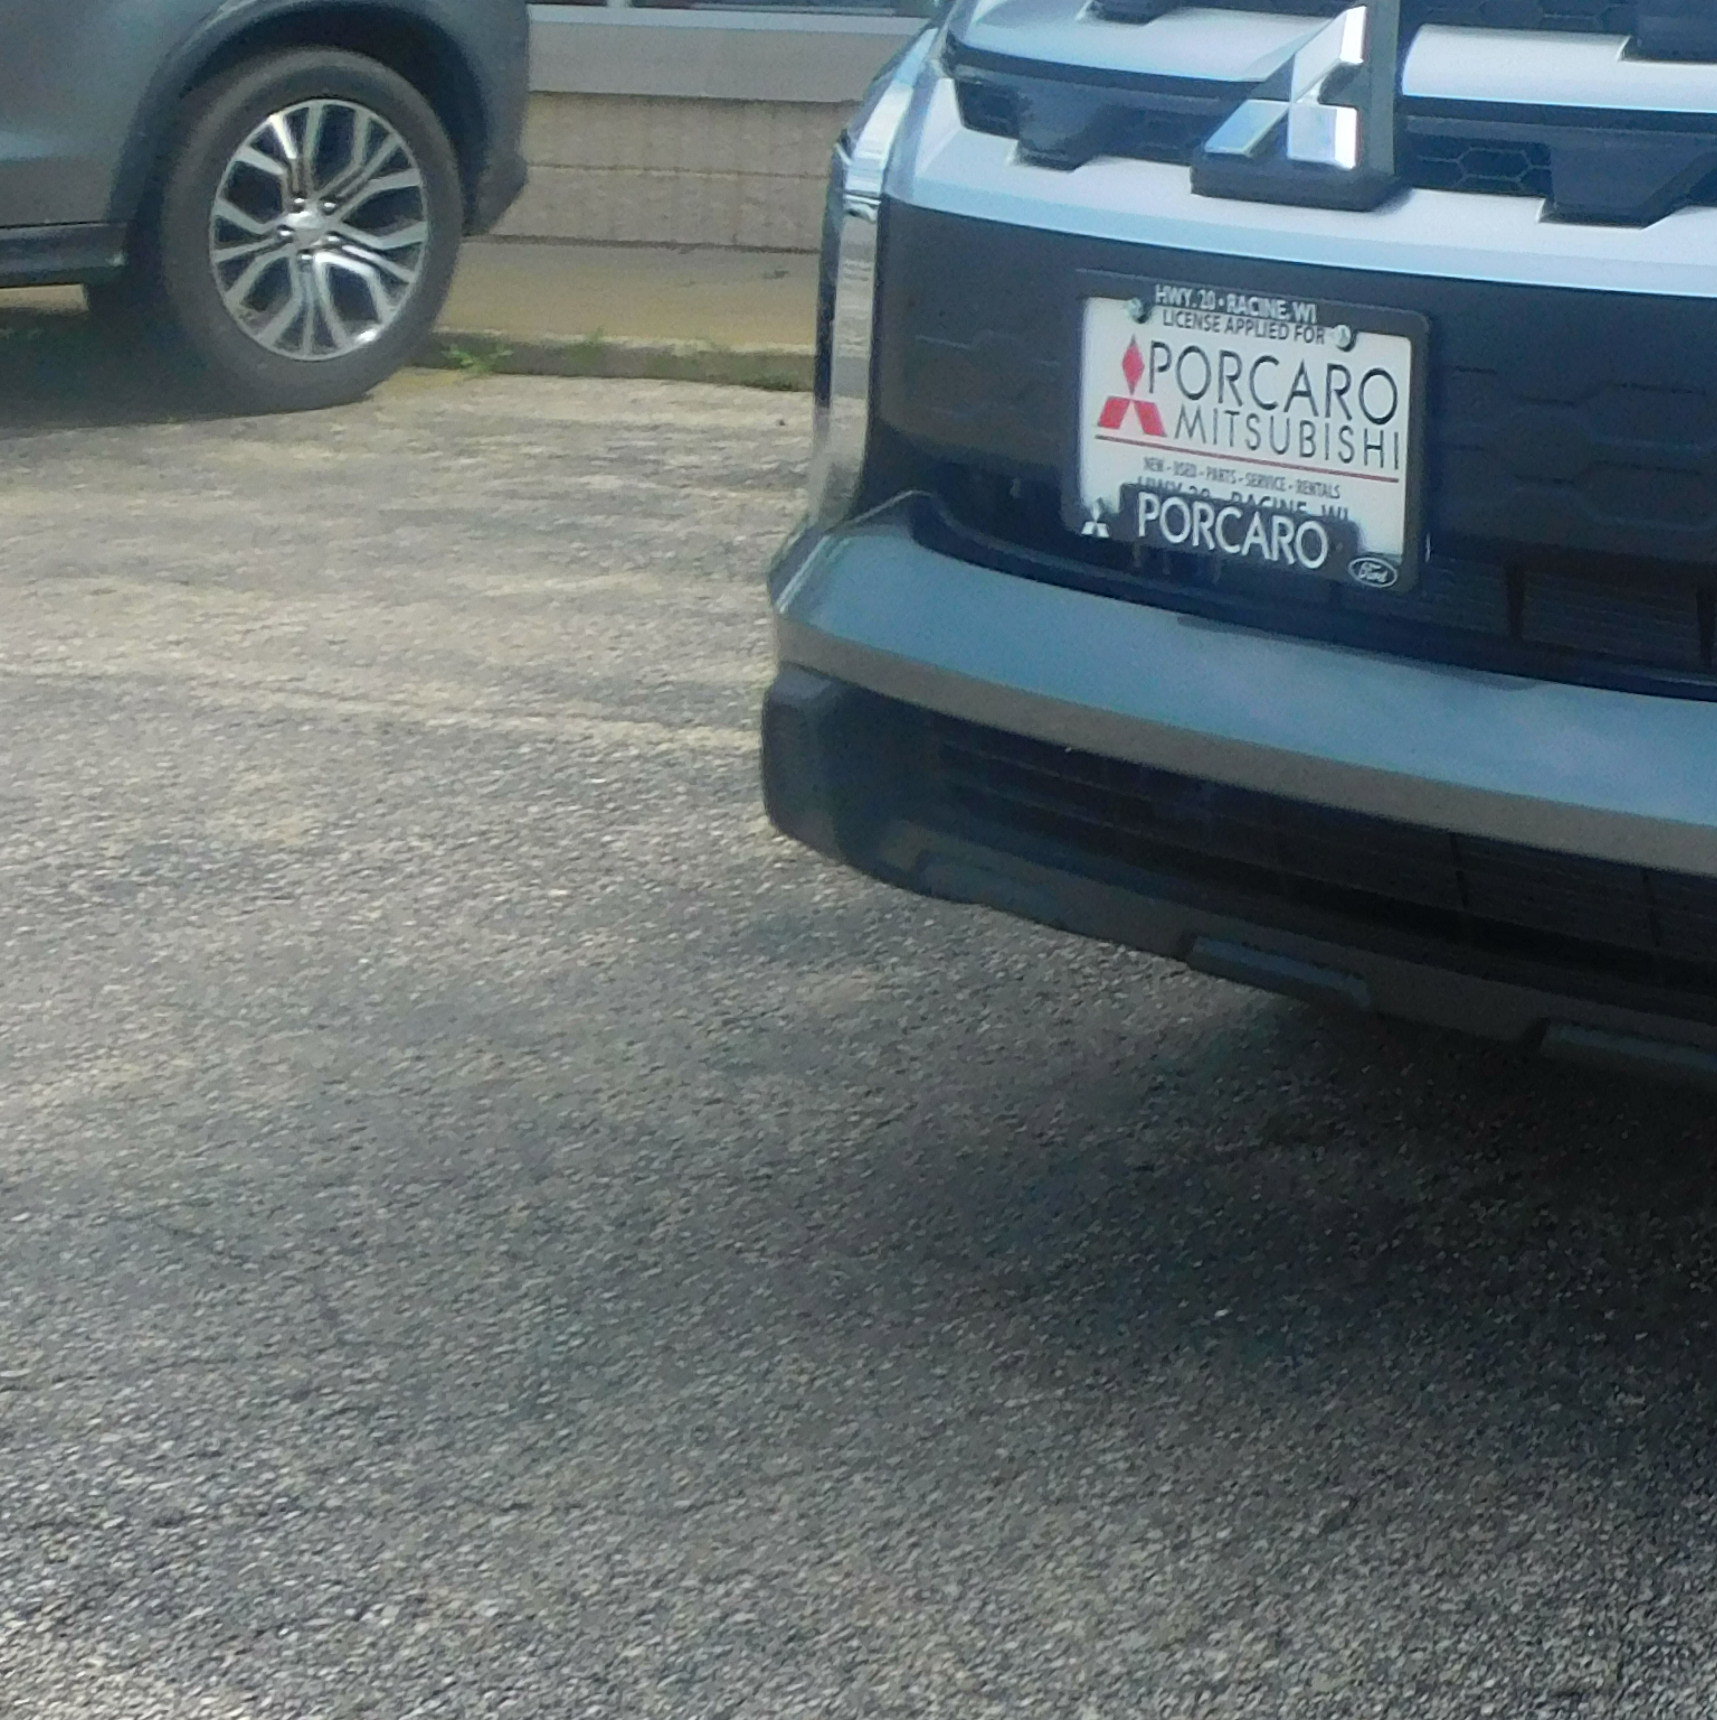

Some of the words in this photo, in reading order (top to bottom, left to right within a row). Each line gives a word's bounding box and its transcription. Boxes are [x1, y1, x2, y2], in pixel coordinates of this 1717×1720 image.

[1163, 309, 1221, 333] LICENSE
[1224, 315, 1290, 340] APPLIED
[1294, 325, 1325, 345] FOR
[1148, 341, 1398, 426] PORCARO
[1174, 402, 1400, 470] MITSUBISHI
[1137, 491, 1329, 569] PORCARO
